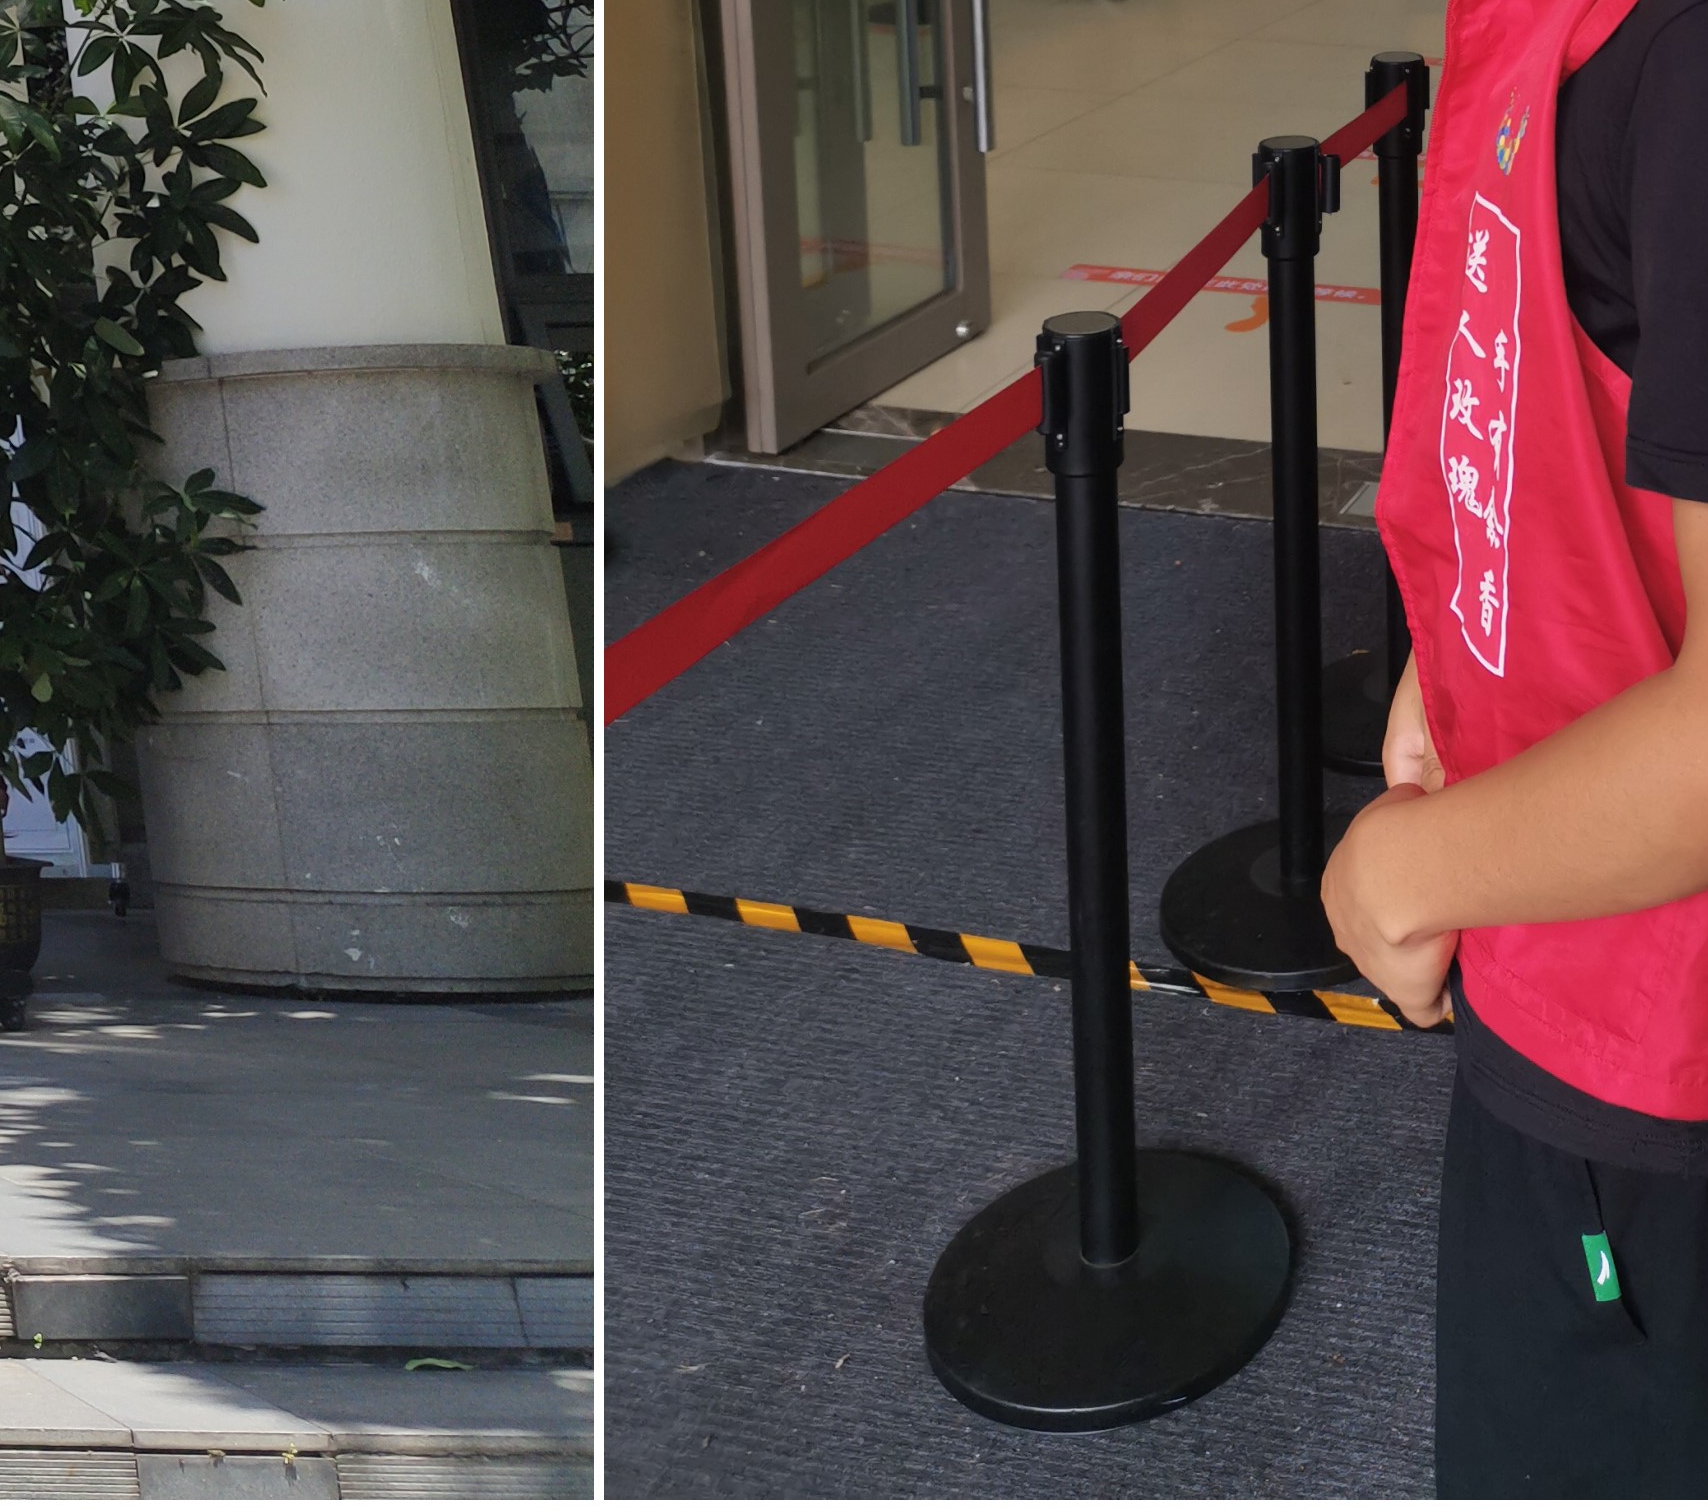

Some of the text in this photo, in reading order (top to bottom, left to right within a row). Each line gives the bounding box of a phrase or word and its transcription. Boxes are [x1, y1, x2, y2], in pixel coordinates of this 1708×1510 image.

[1448, 231, 1487, 516] 送人玫瑰
[1480, 329, 1511, 637] 手有余香
